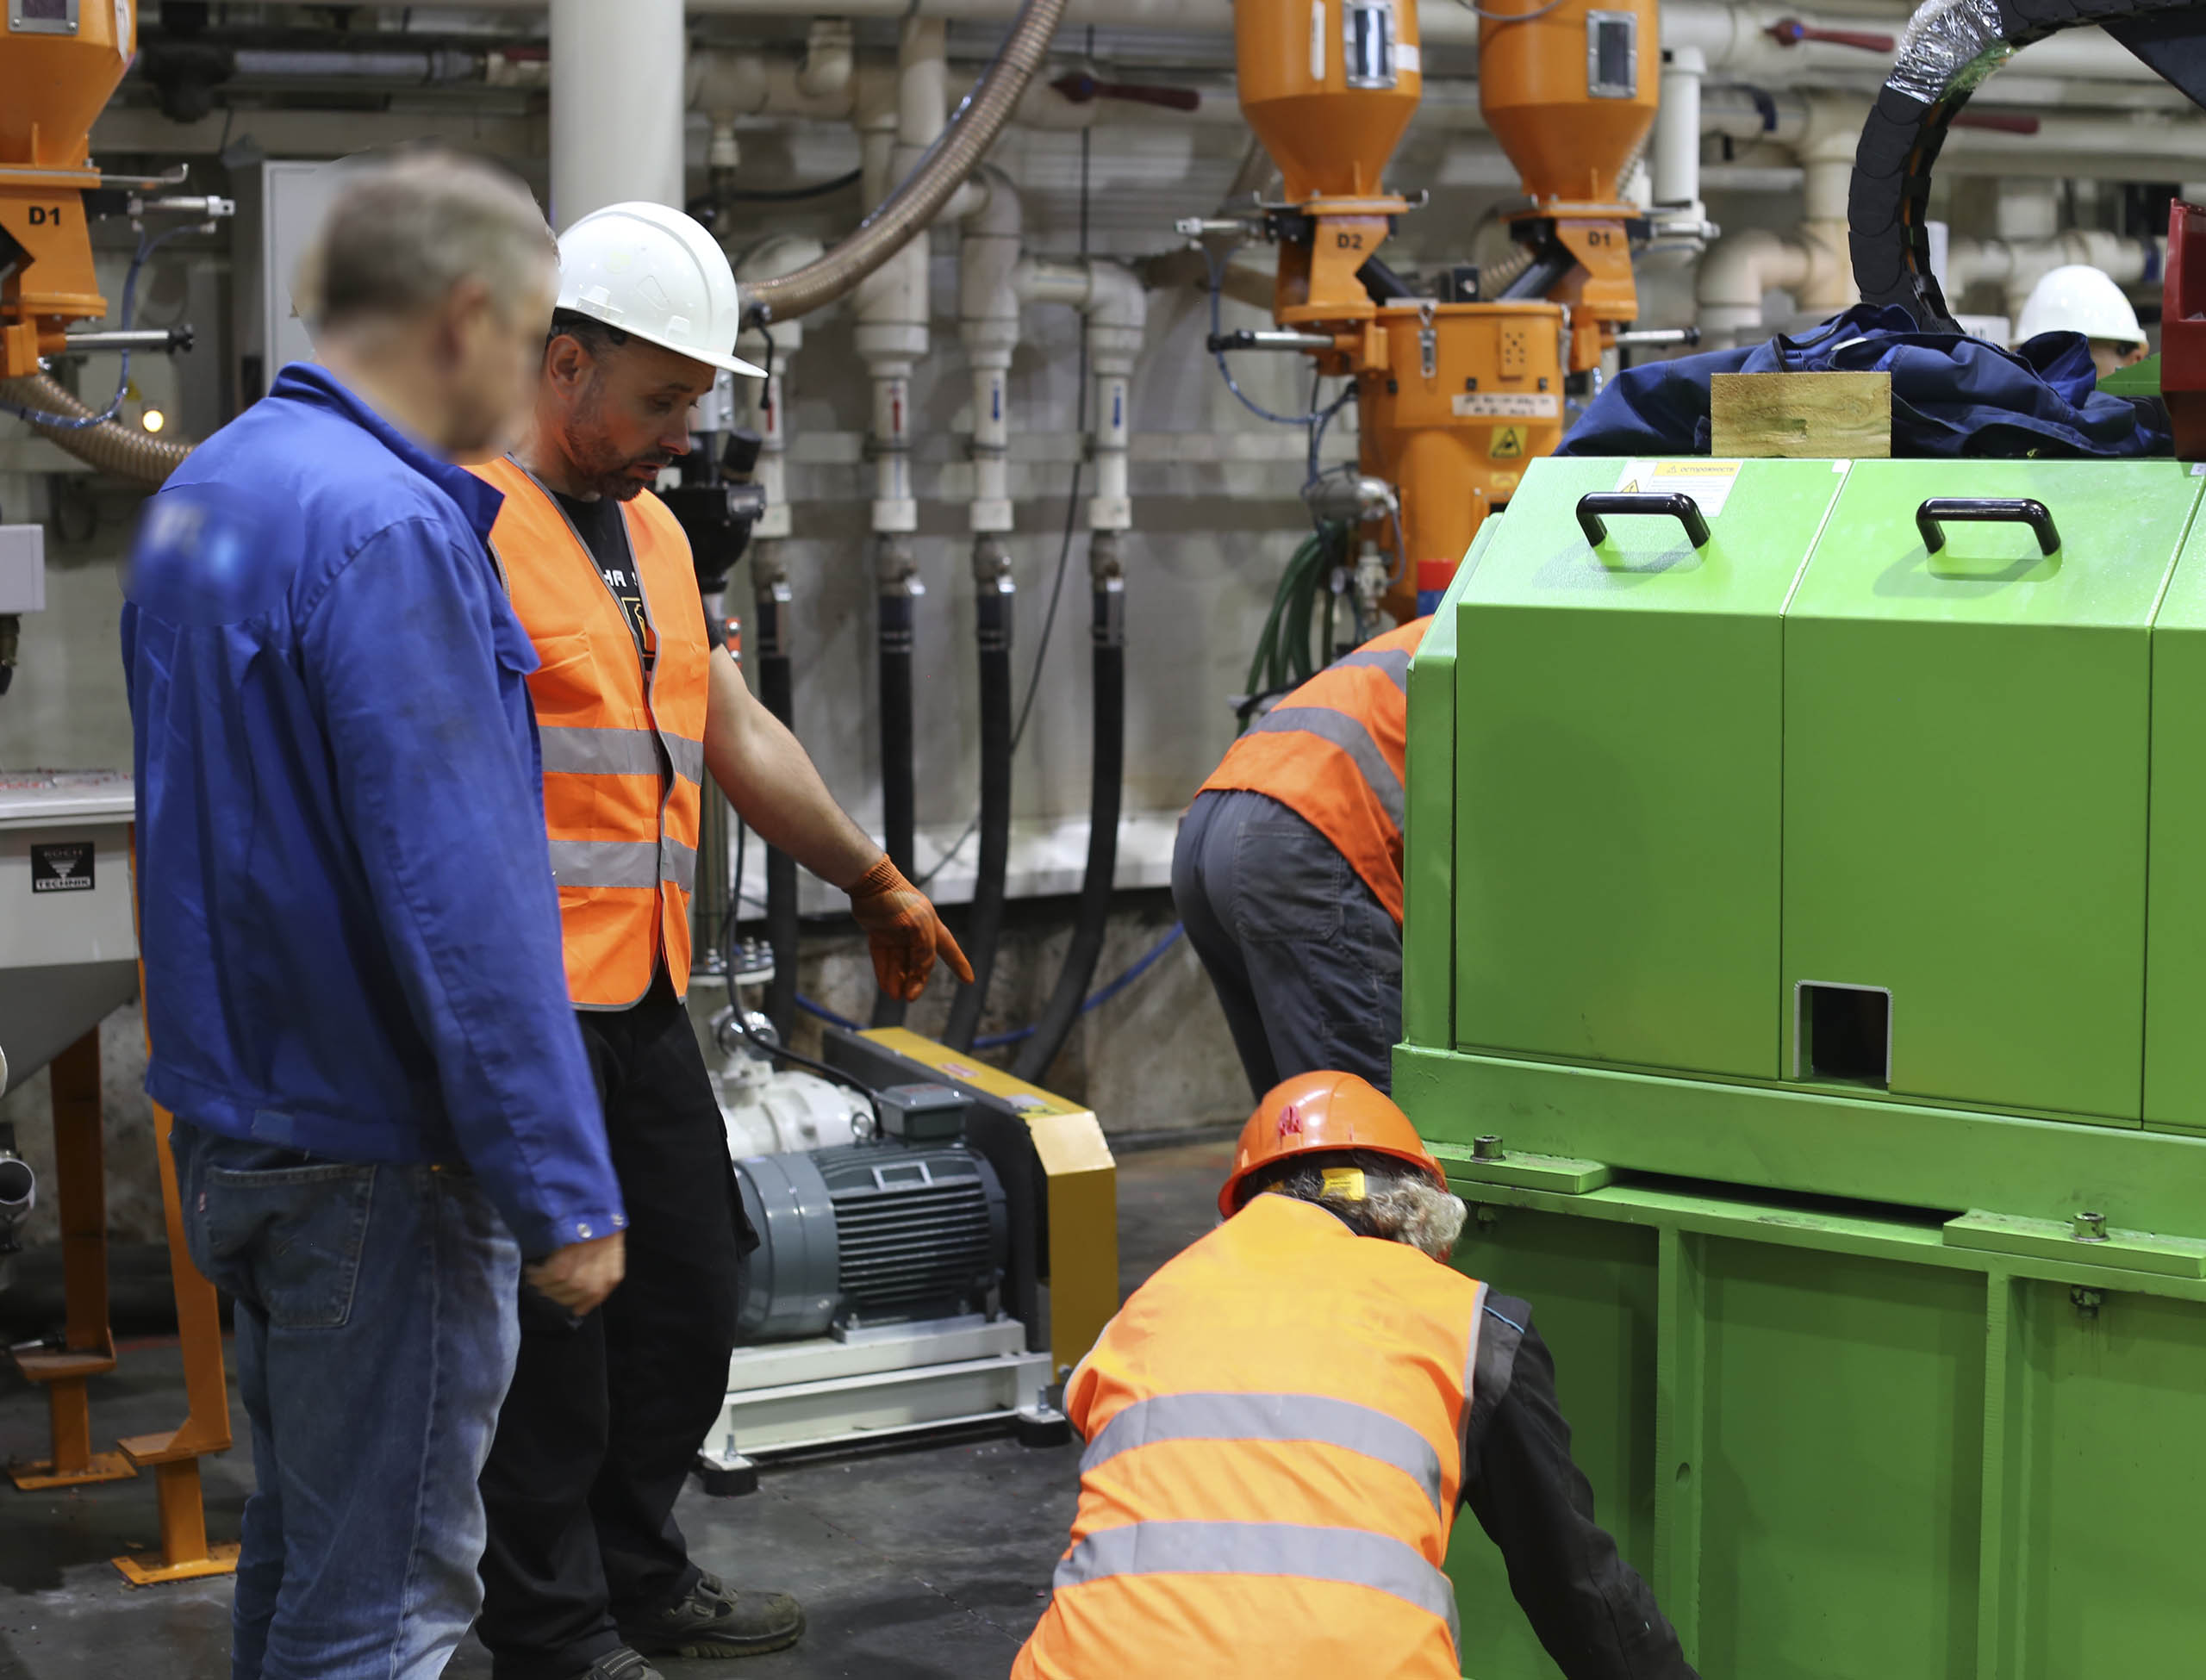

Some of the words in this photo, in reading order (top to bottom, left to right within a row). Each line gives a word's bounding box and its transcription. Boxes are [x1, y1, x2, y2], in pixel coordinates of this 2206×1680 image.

[29, 206, 60, 226] D1
[1337, 233, 1362, 249] D2
[1589, 231, 1610, 246] D1
[36, 877, 90, 889] TECHNIK
